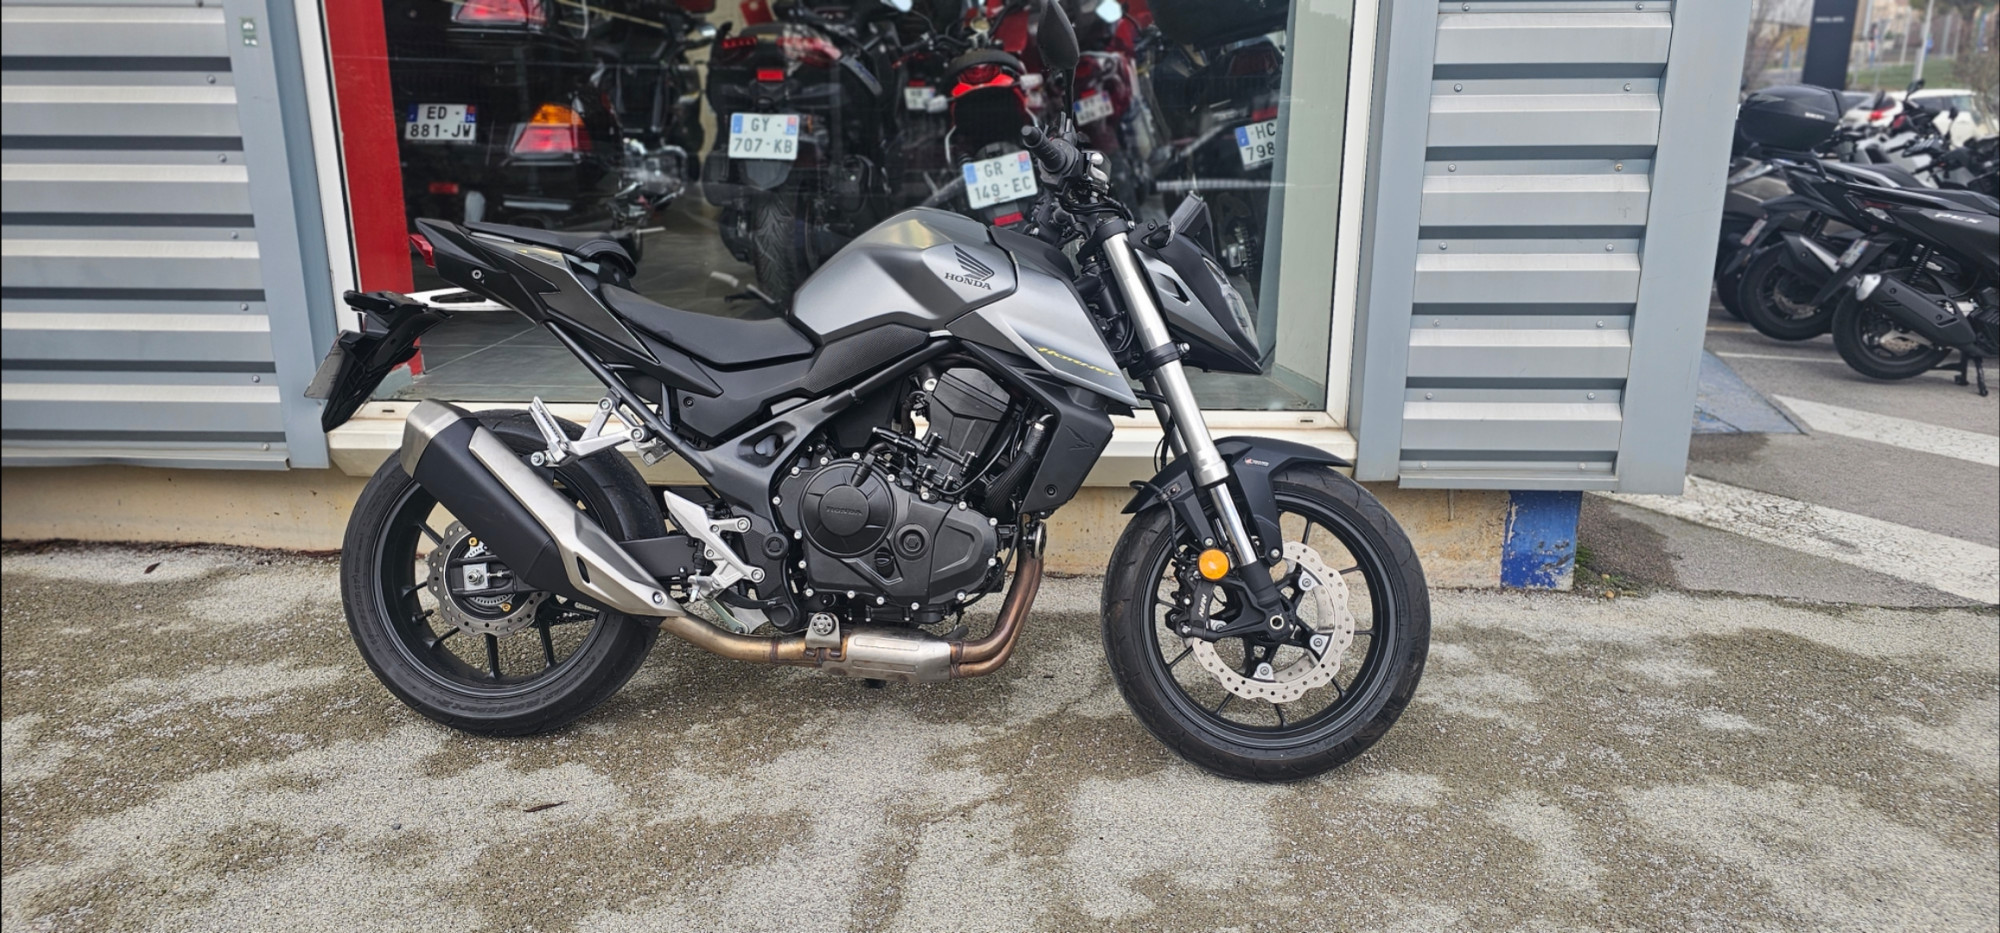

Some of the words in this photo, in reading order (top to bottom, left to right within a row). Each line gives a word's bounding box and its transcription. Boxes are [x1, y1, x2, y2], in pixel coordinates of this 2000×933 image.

[427, 106, 447, 120] ED
[410, 123, 472, 137] 881-JW
[751, 117, 769, 132] GY
[1255, 122, 1276, 139] HC
[733, 137, 793, 153] 707-KB
[1245, 141, 1276, 161] 798
[984, 161, 1003, 177] GR
[974, 176, 1032, 202] 149-EC
[944, 272, 992, 290] HONDA
